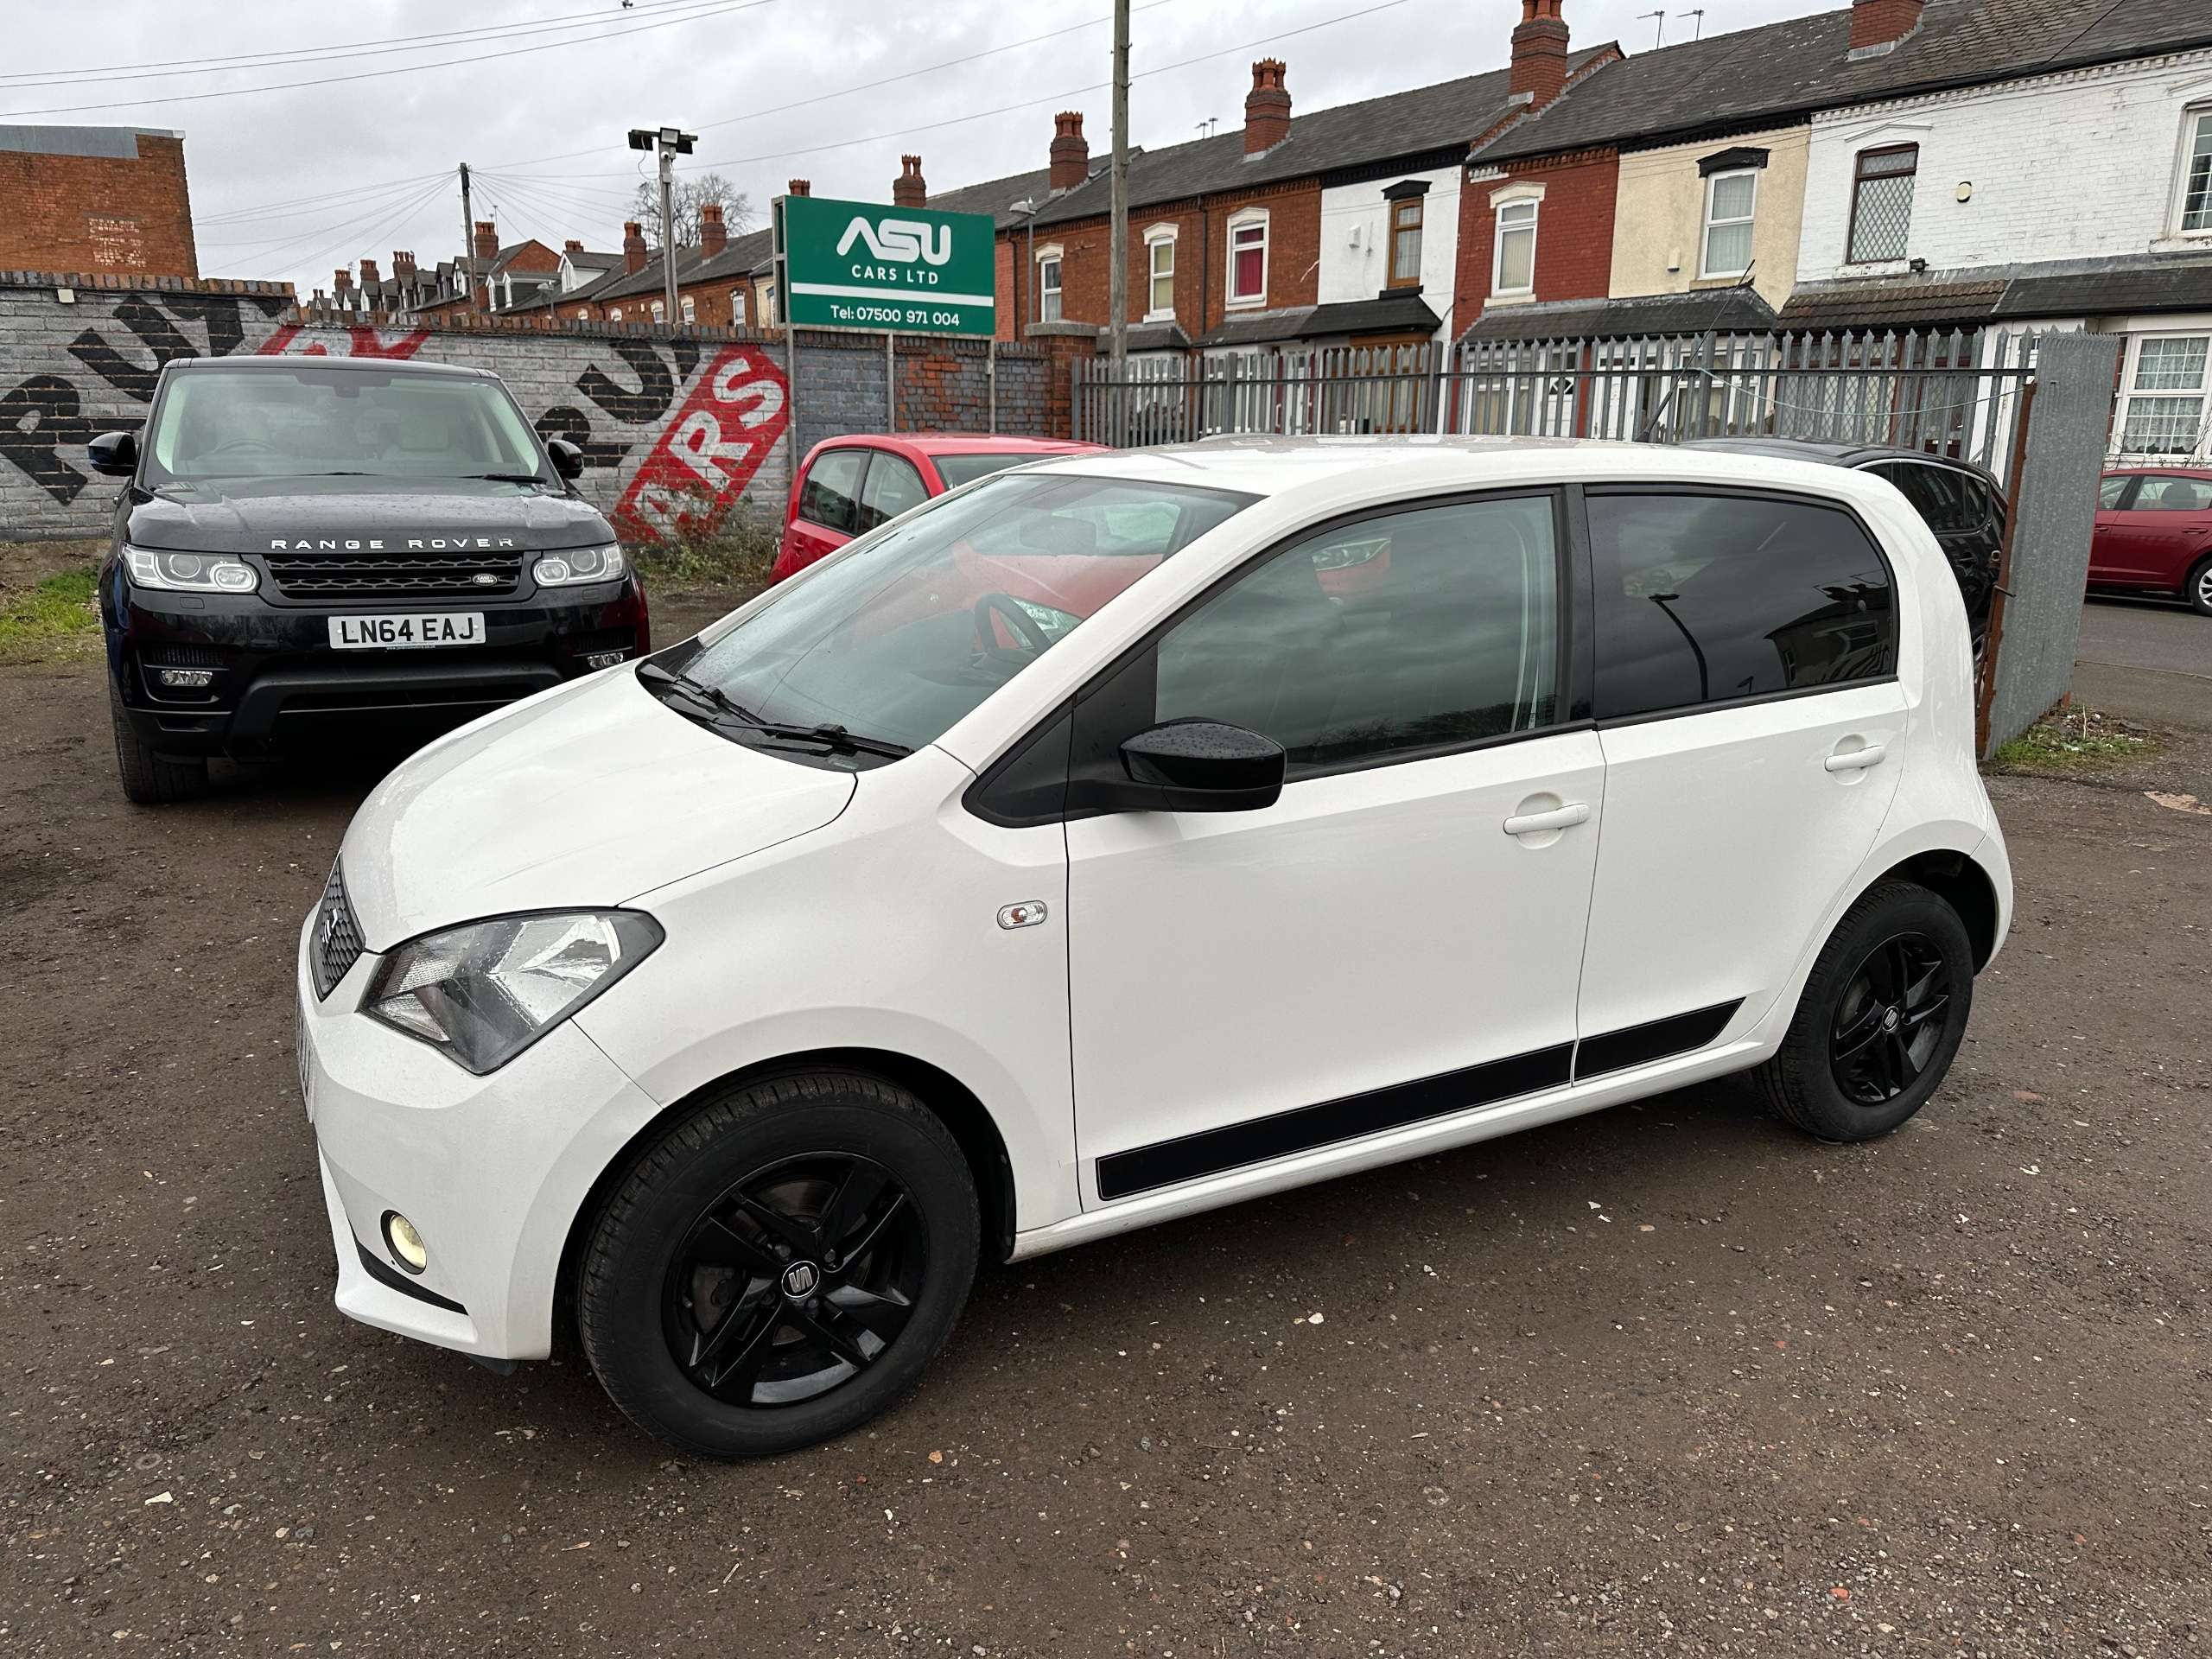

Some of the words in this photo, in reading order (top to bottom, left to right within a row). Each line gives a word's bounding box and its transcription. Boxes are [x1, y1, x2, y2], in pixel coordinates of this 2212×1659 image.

[836, 216, 951, 265] ASU
[851, 264, 897, 281] CARS
[907, 270, 938, 284] LTD
[906, 310, 928, 324] 971
[933, 312, 960, 327] 004
[271, 539, 385, 550] RANGE
[408, 538, 513, 549] ROVER
[341, 619, 413, 644] LN64
[422, 617, 474, 641] EAJ
